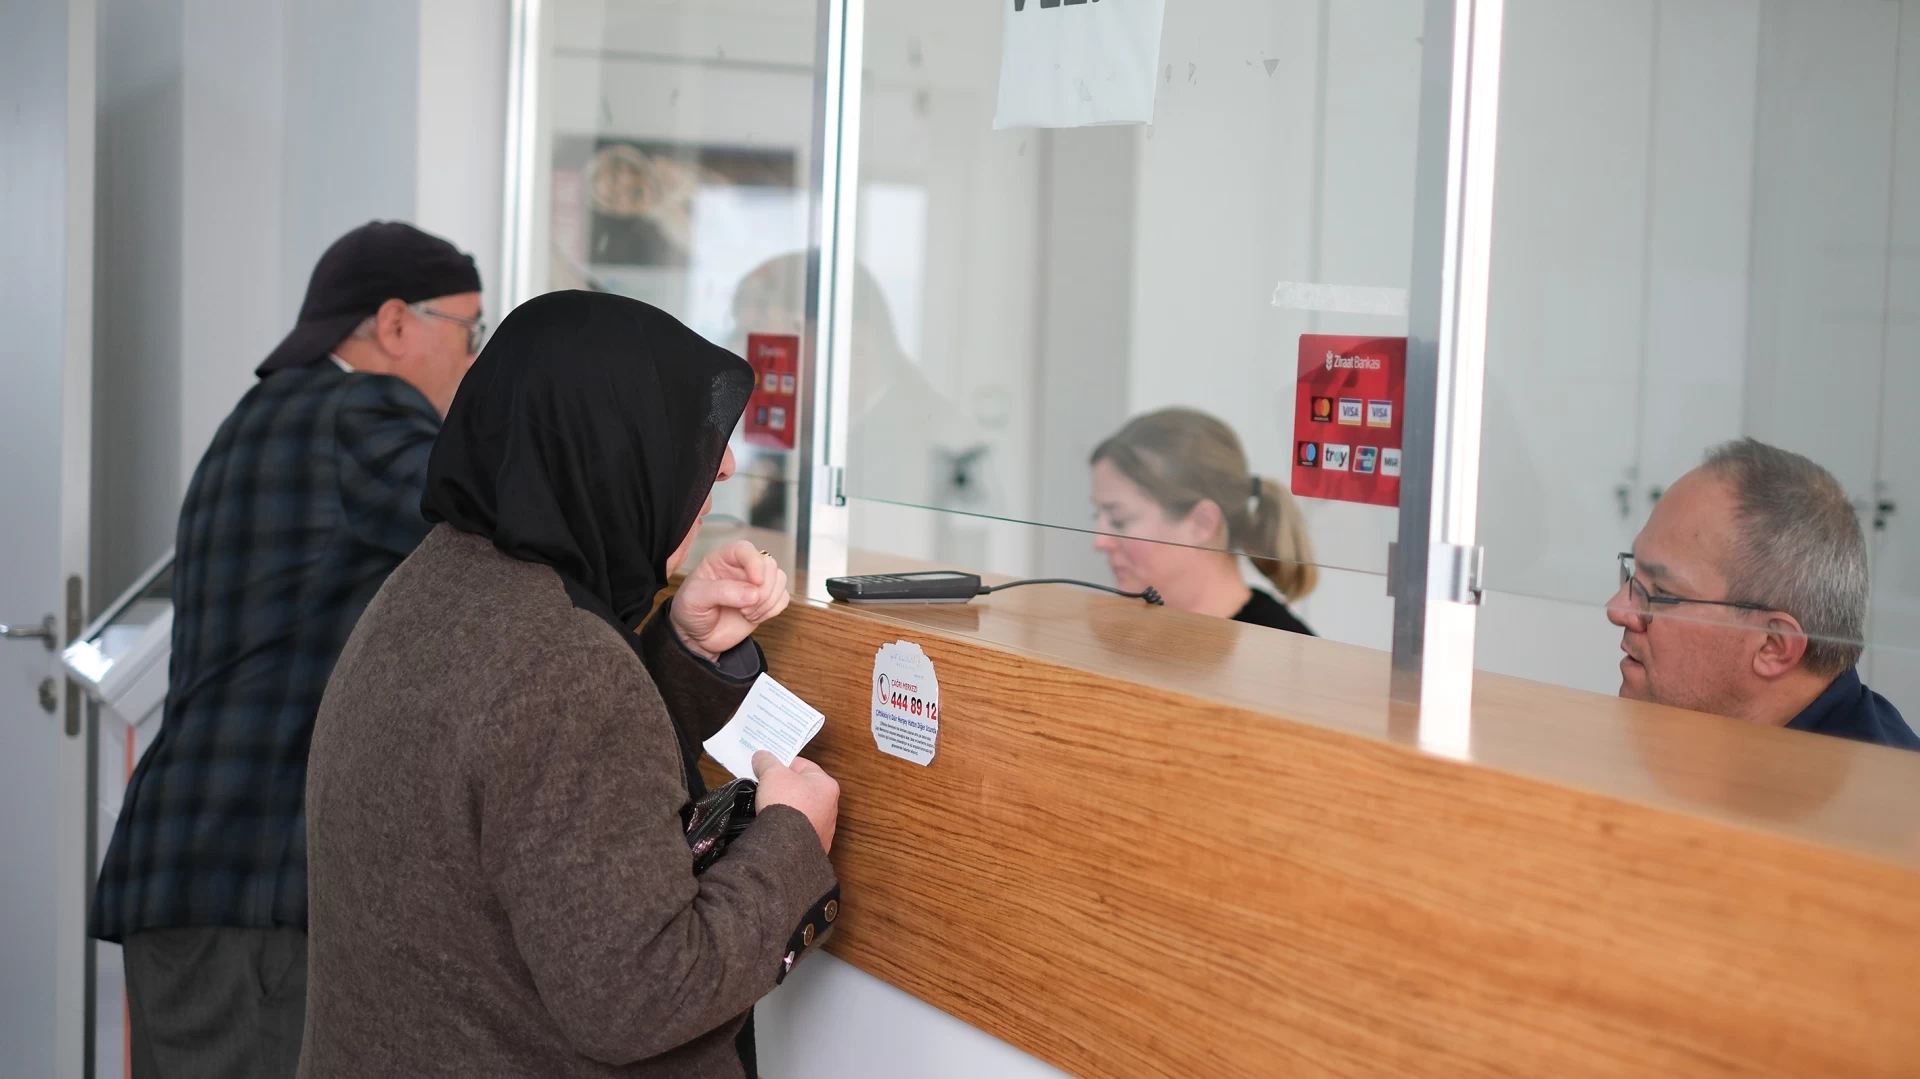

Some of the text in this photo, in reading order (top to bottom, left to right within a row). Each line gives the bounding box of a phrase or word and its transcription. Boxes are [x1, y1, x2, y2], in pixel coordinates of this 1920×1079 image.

[1334, 355, 1353, 368] Ziraat
[1342, 406, 1359, 417] VISA
[1371, 407, 1388, 418] VISA
[1325, 448, 1348, 467] troy
[891, 692, 937, 720] 444 89 12
